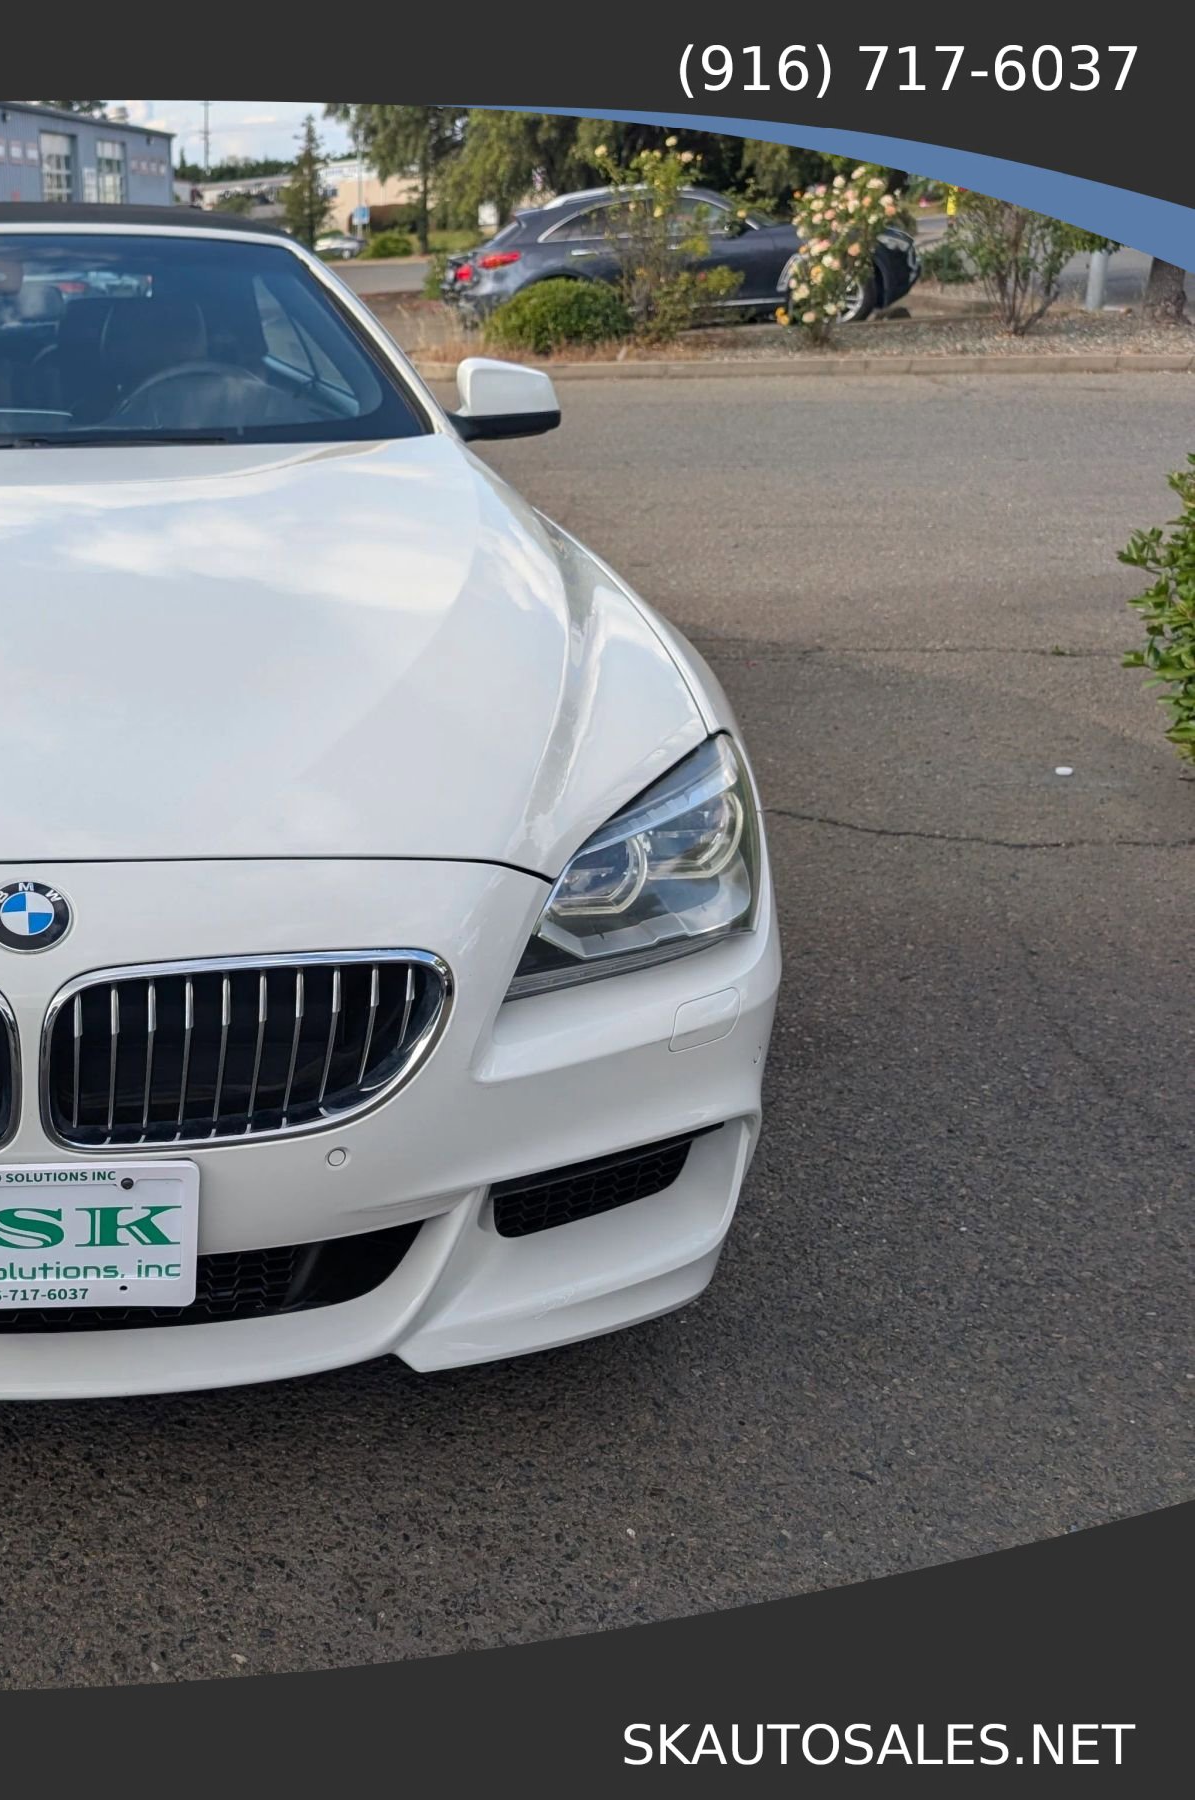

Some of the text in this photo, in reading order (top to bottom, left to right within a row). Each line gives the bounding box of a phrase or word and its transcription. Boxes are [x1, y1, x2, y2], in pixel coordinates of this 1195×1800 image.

[5, 1171, 88, 1184] SOLUTIONS
[91, 1170, 117, 1182] INC
[137, 1259, 182, 1278] inc
